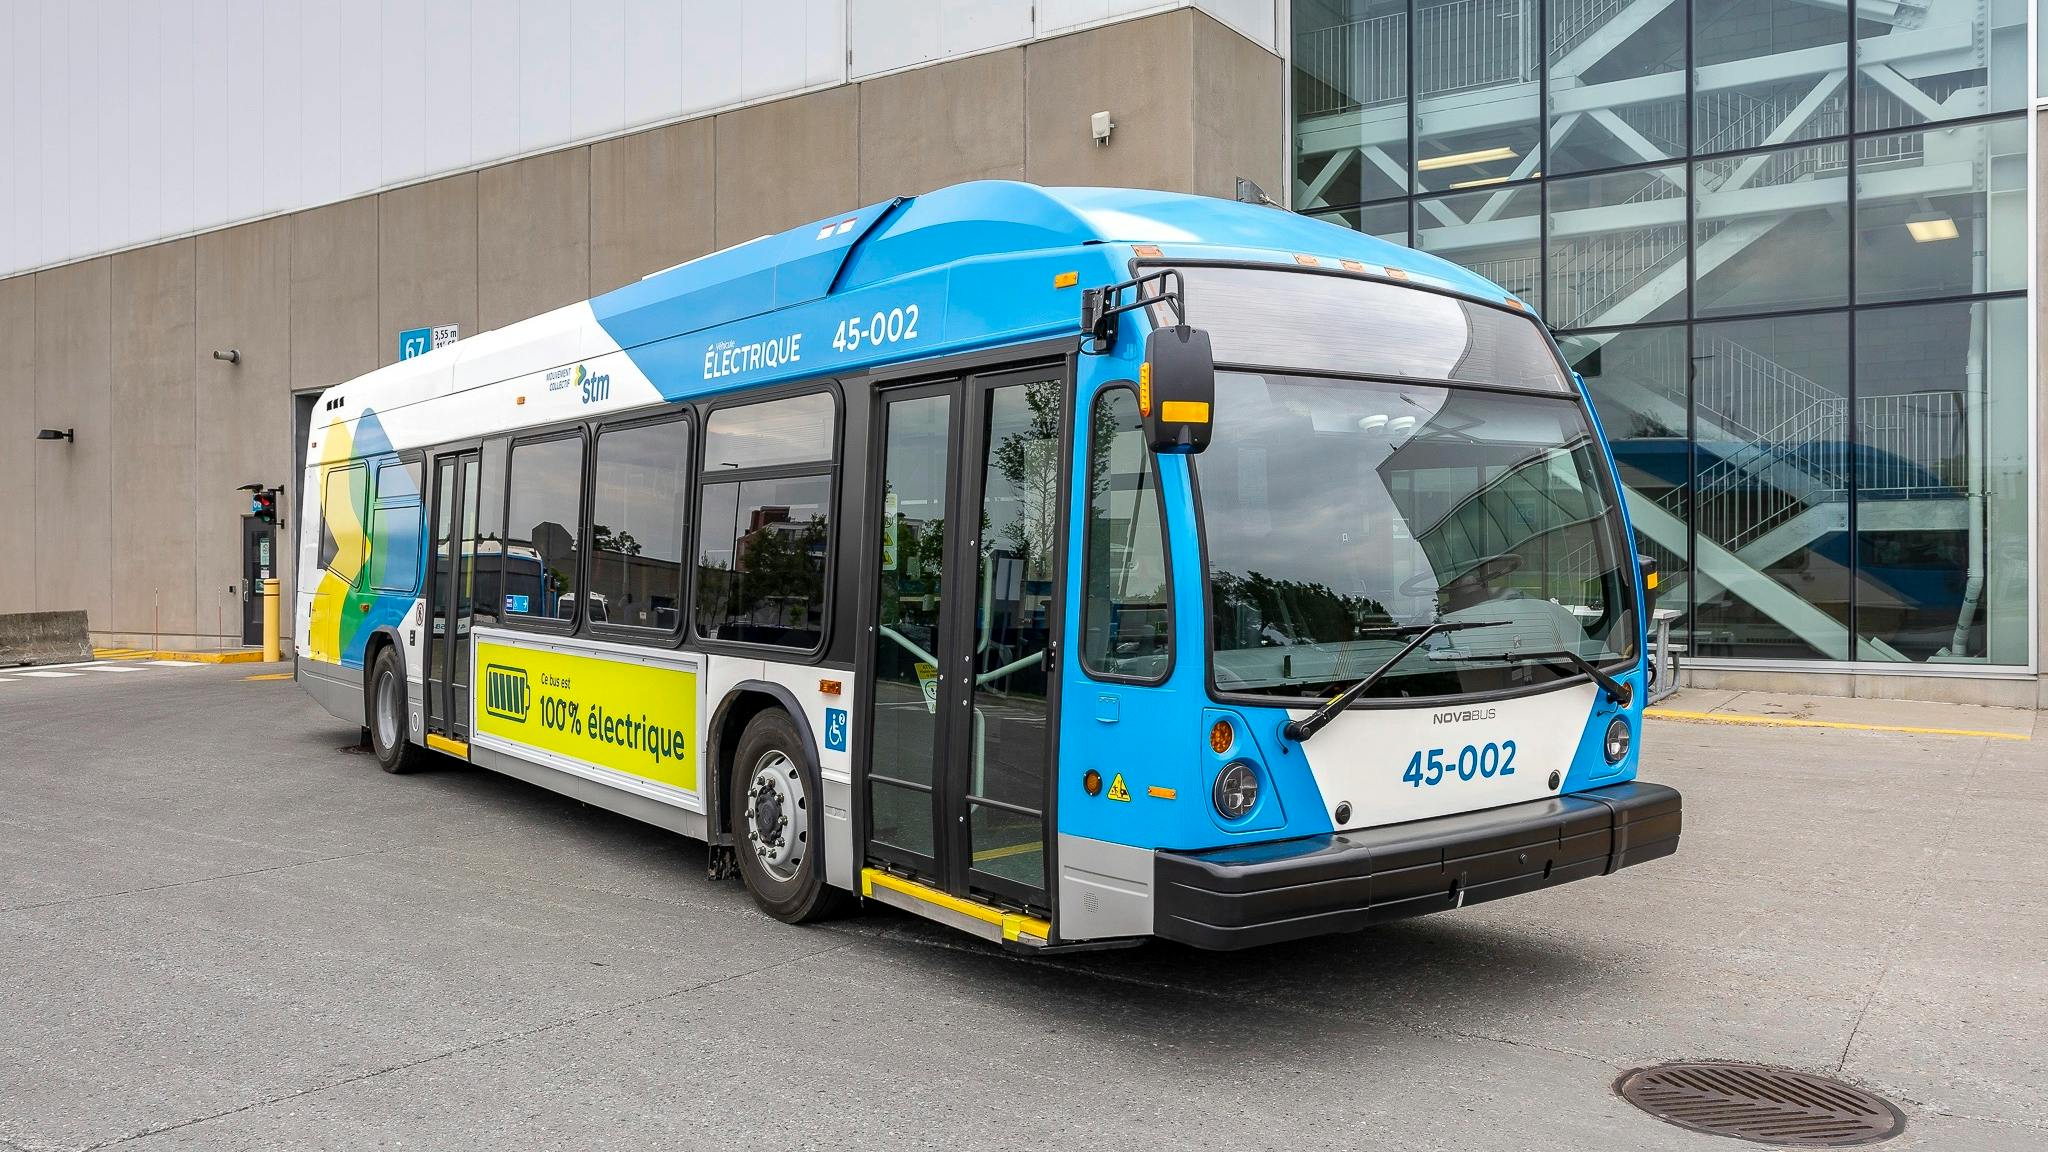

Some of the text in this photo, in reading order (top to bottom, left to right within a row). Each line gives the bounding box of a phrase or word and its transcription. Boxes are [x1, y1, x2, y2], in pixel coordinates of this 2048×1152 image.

[434, 329, 457, 341] 3,55 m
[832, 304, 919, 353] 45-002
[405, 337, 425, 360] 67
[703, 333, 802, 380] ÉLECTRIQUE
[546, 367, 572, 381] MOUVEMENT
[549, 379, 571, 392] COLLECTIF
[582, 371, 610, 405] stm
[541, 672, 571, 690] Ce bus est
[540, 695, 685, 764] 100% électrique
[1402, 739, 1516, 788] 45-002
